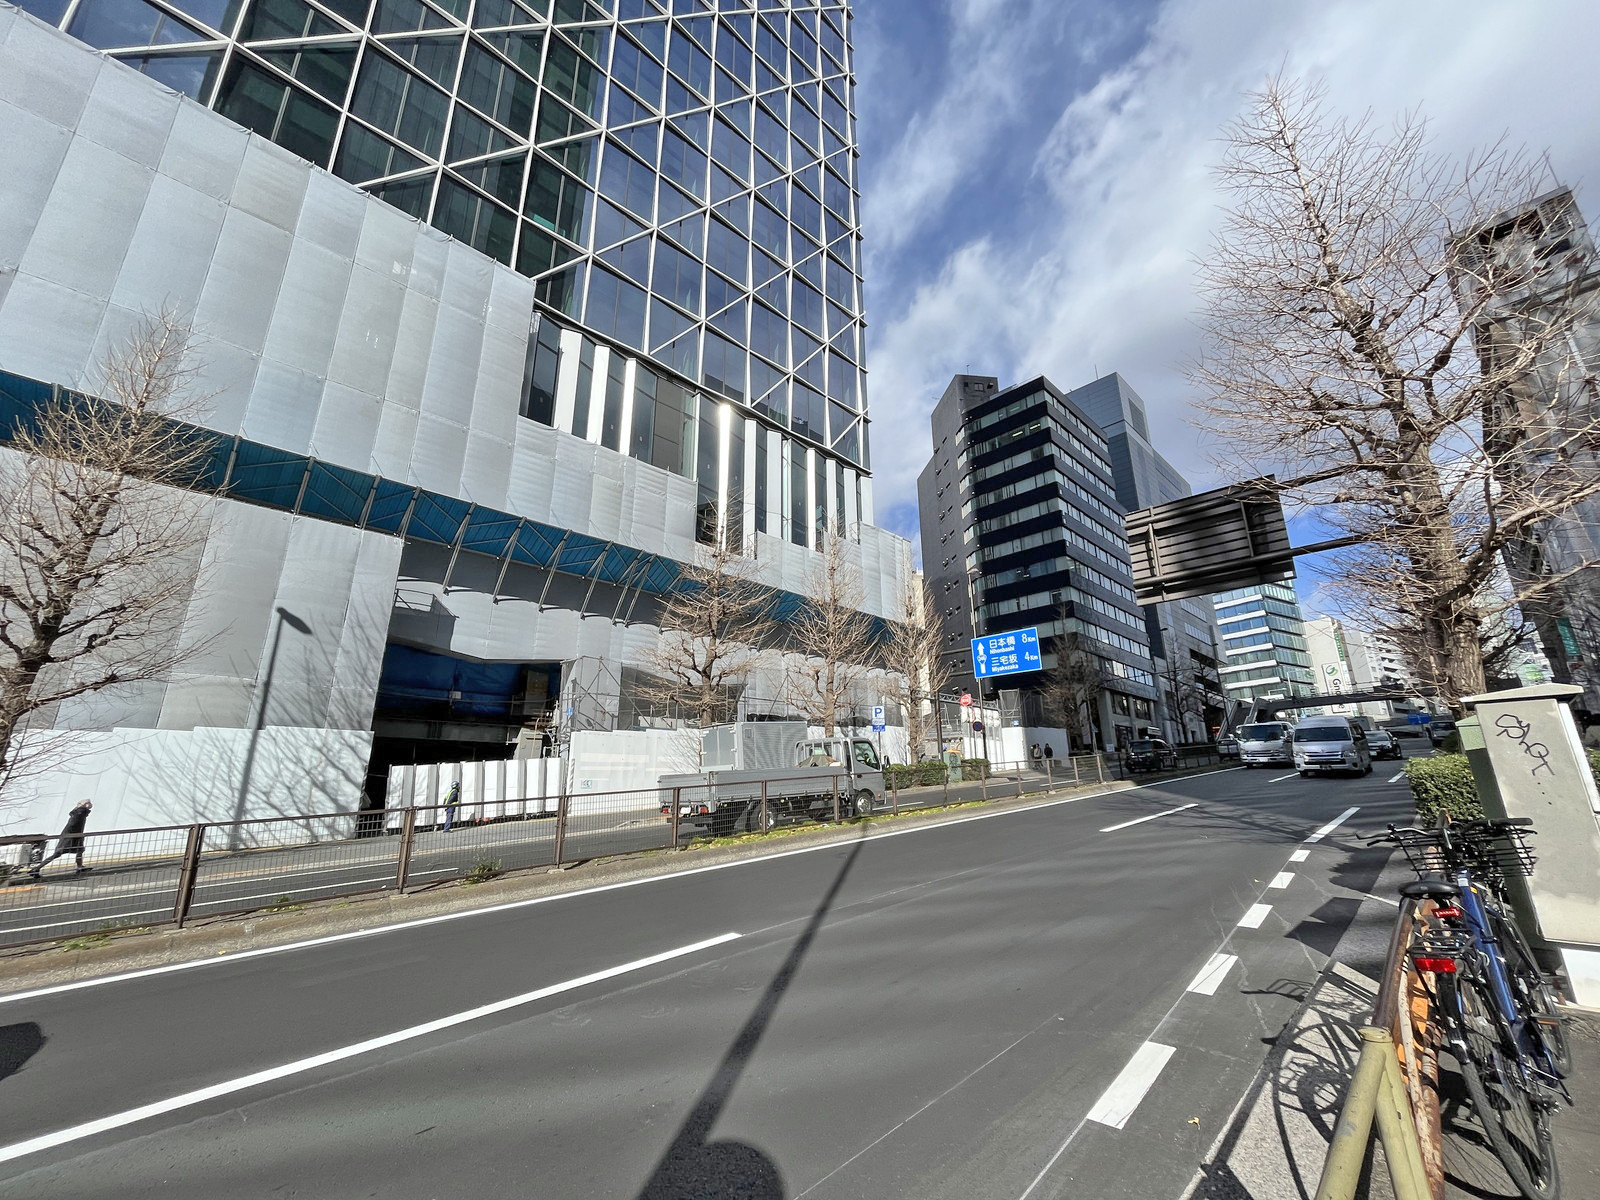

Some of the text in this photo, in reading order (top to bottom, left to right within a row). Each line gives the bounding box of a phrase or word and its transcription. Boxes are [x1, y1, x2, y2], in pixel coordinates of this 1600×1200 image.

[989, 636, 1016, 648] 日本橋
[991, 654, 1018, 666] 三宅坂
[874, 707, 882, 718] P
